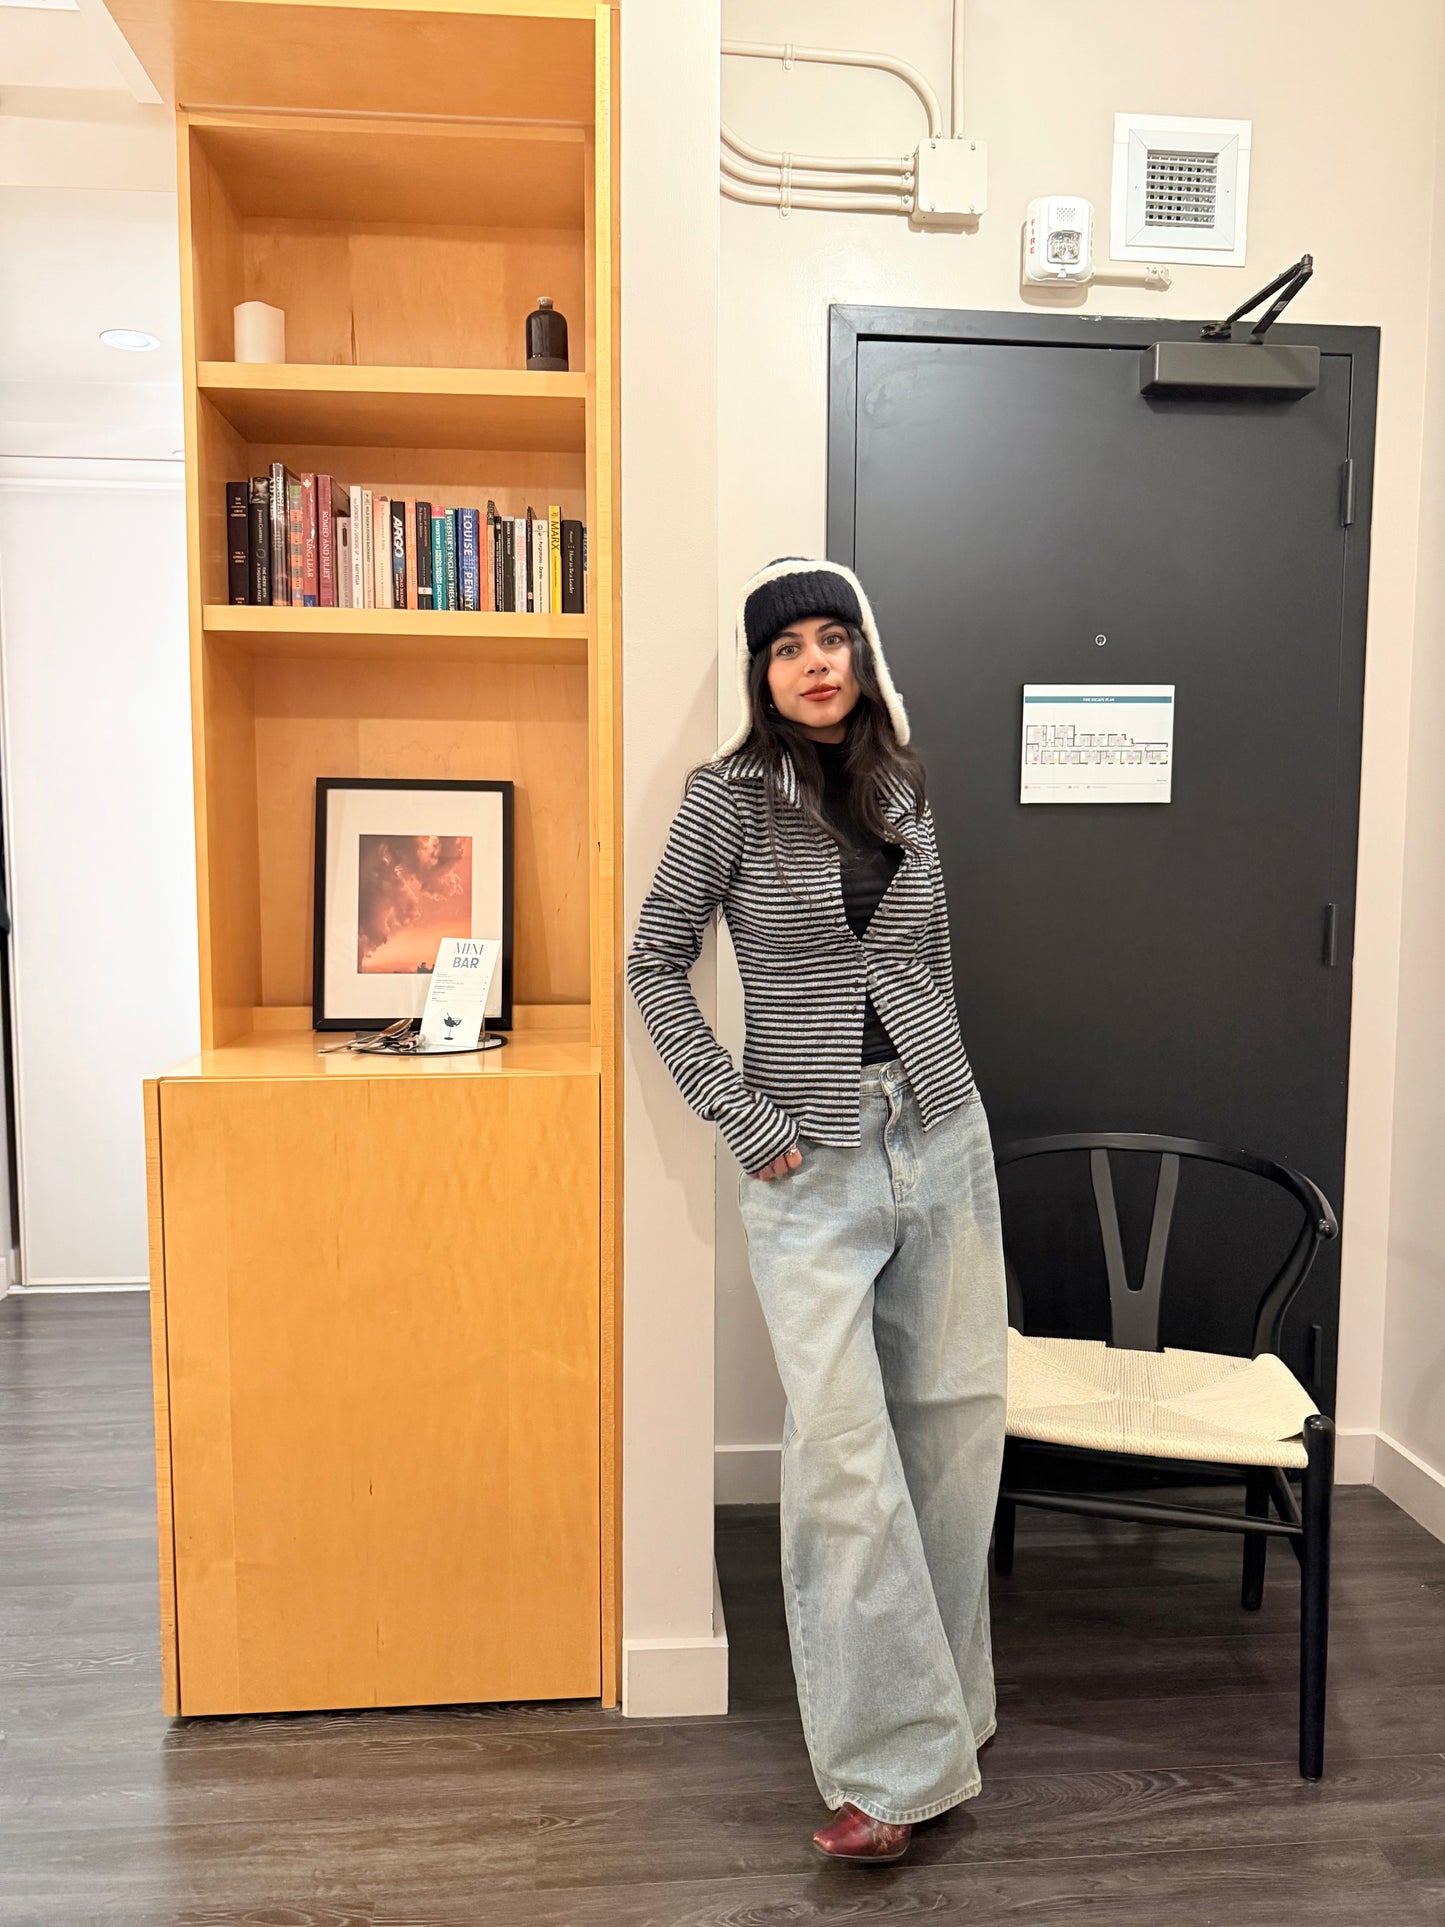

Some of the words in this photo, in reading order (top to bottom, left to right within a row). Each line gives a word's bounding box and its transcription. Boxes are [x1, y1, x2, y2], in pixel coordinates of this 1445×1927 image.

[393, 516, 404, 558] ARGO
[463, 515, 473, 556] LOUISE
[551, 521, 559, 550] MARX
[322, 556, 330, 579] JULIET
[464, 572, 474, 610] PENNY
[452, 957, 479, 969] BAR
[453, 942, 484, 955] MINI
